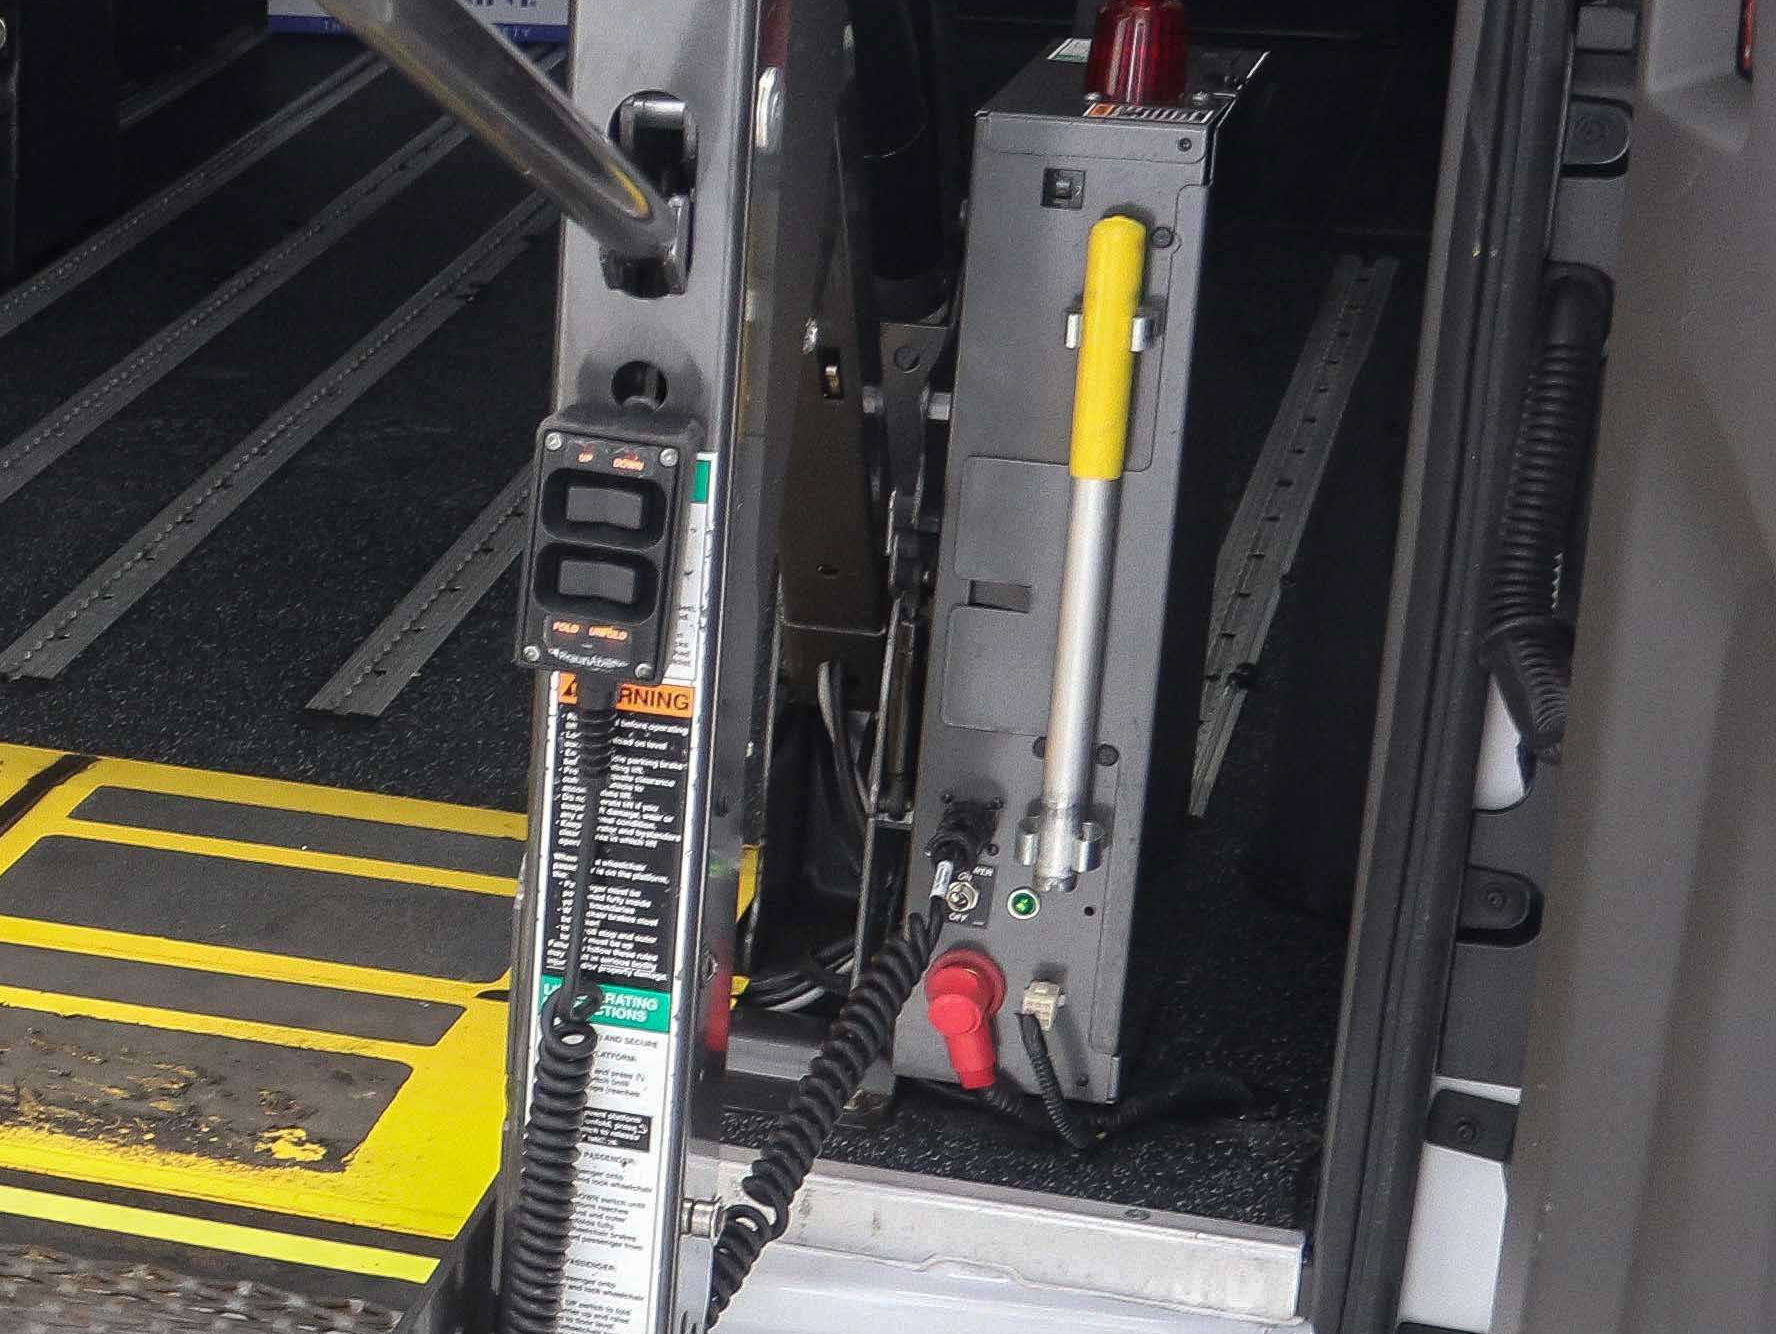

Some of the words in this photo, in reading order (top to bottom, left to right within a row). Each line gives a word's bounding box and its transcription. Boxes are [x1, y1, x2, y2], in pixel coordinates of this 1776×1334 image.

[589, 626, 628, 641] UNFOLD
[619, 687, 689, 711] RNING
[603, 992, 658, 1011] RATING
